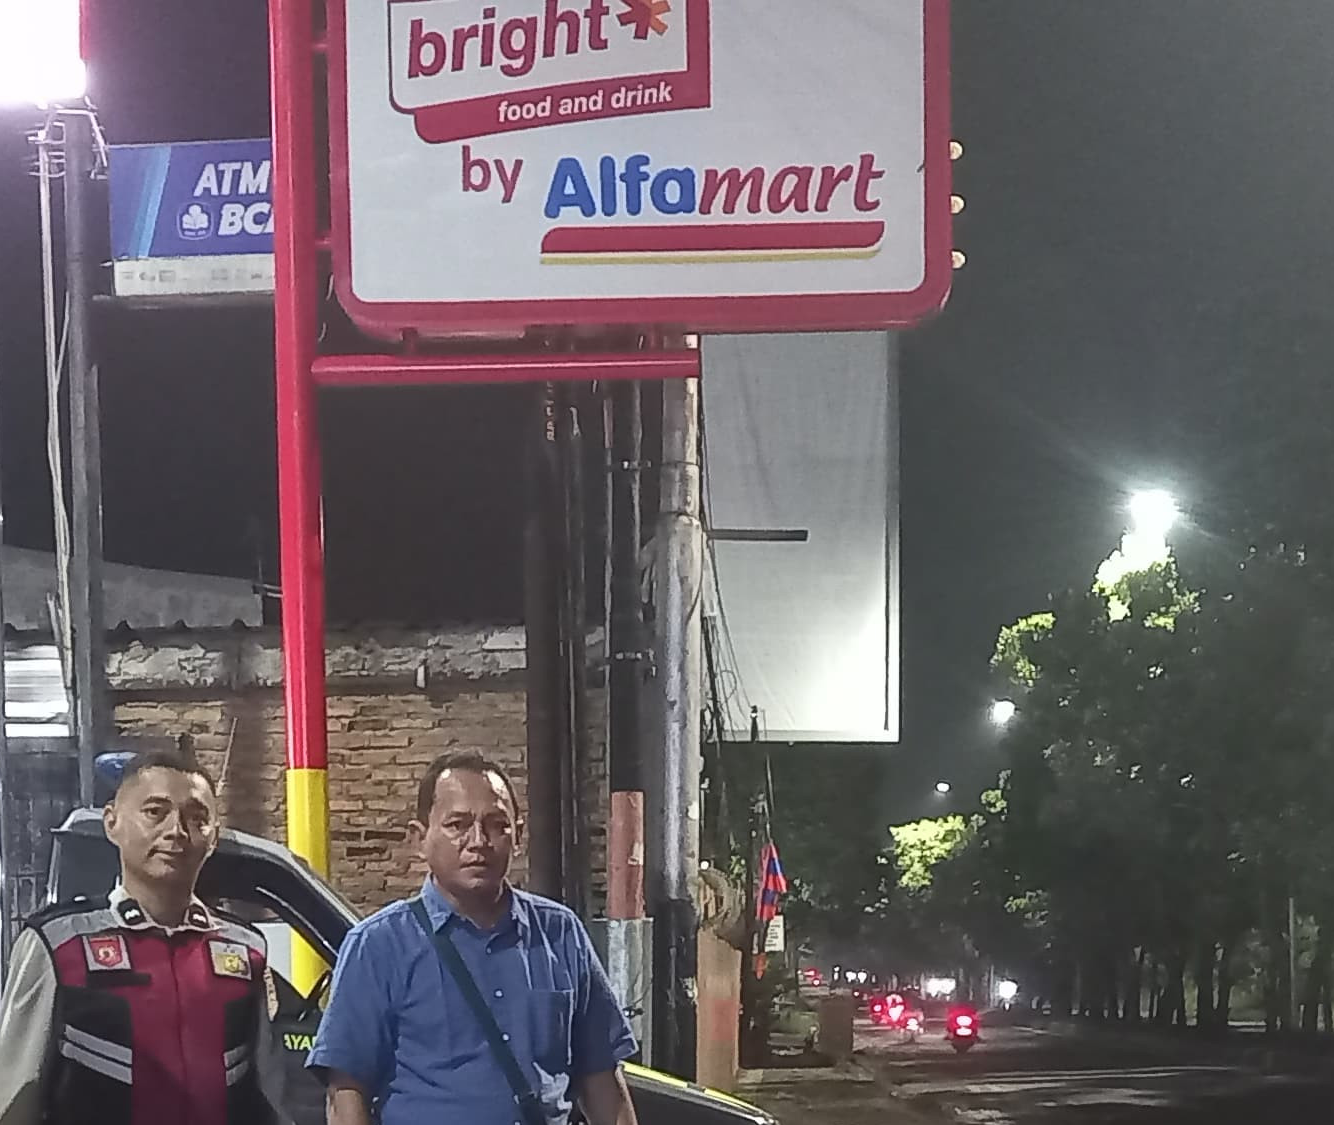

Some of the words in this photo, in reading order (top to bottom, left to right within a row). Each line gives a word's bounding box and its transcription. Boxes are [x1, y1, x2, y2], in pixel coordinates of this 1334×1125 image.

[407, 0, 610, 79] bright
[497, 99, 552, 123] food
[558, 89, 604, 116] and
[610, 80, 673, 111] drink
[192, 159, 272, 198] ATM
[461, 144, 524, 204] by
[543, 152, 886, 219] Alfamart
